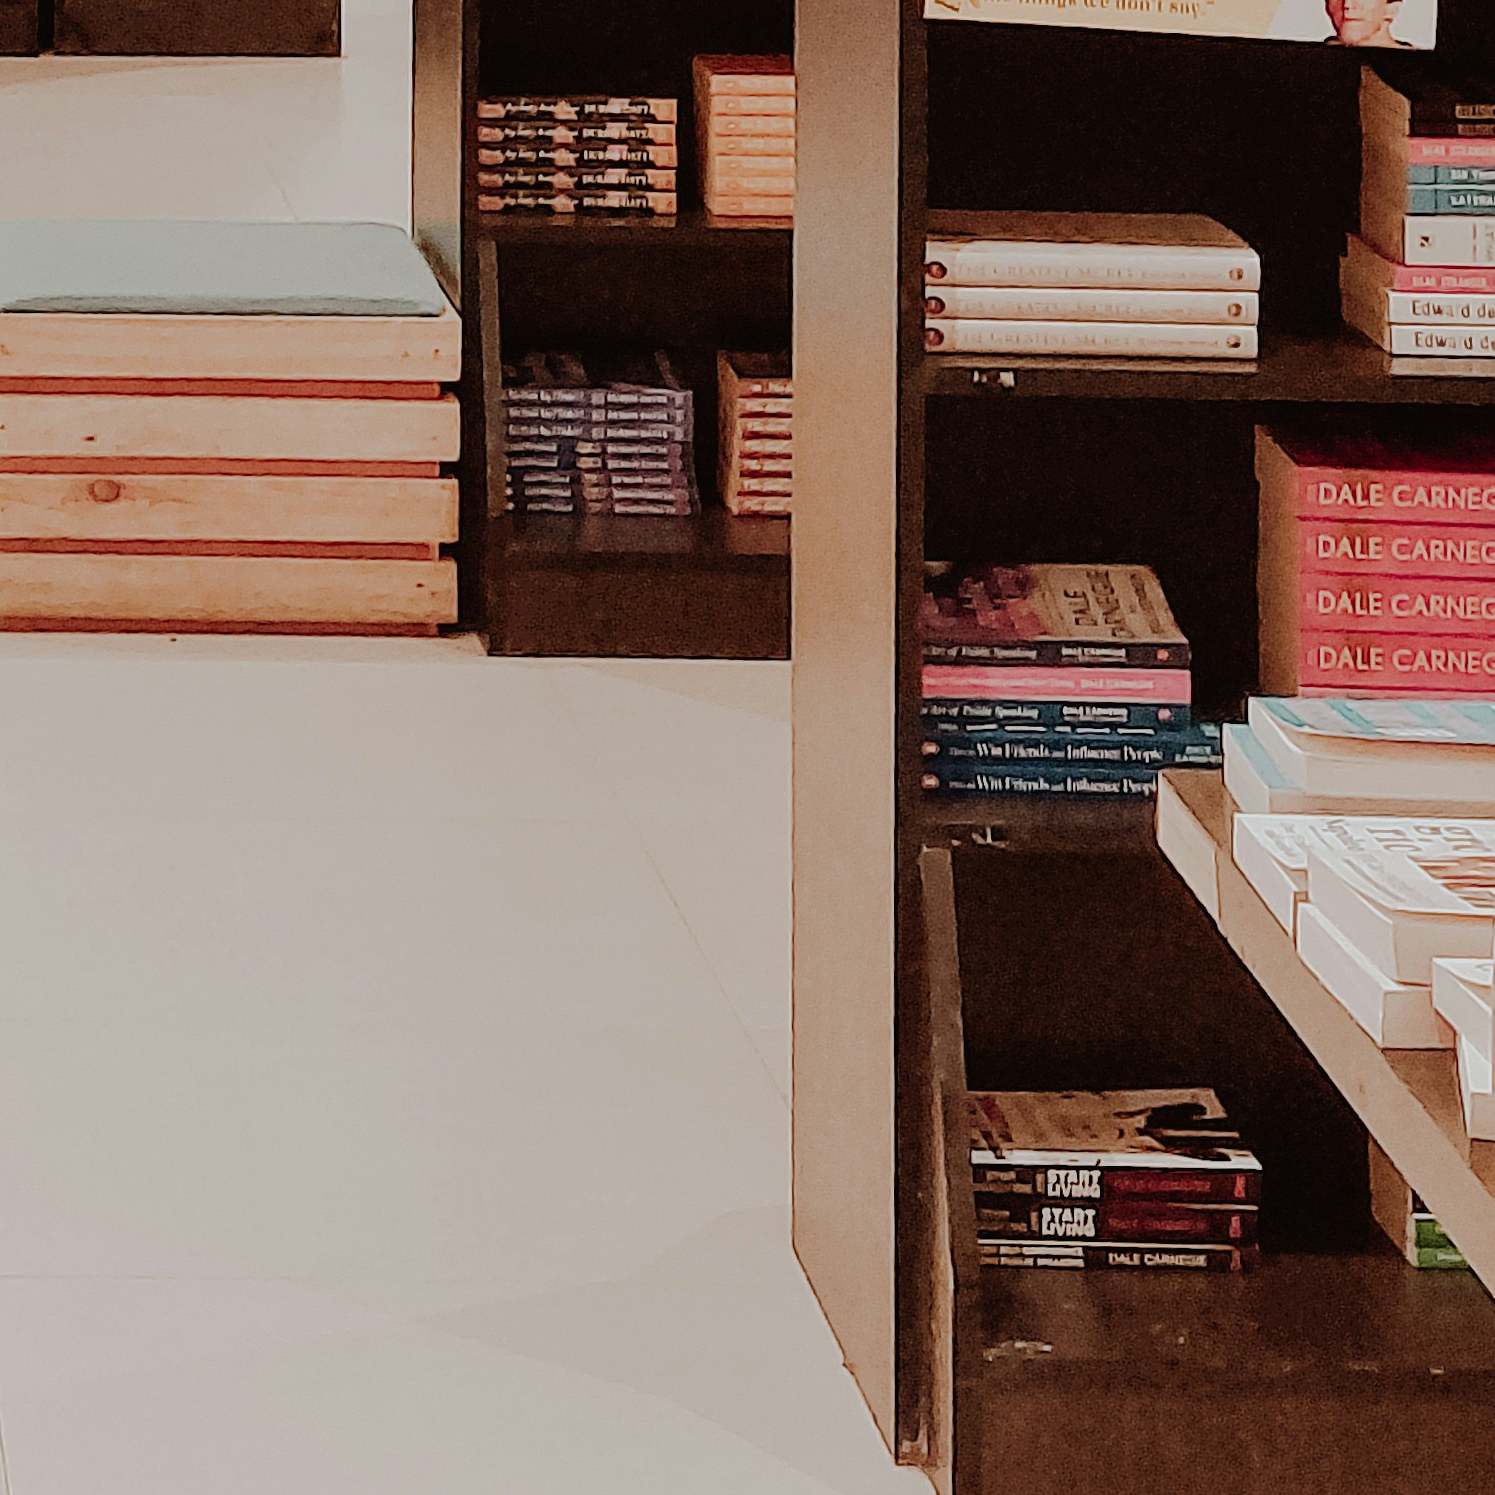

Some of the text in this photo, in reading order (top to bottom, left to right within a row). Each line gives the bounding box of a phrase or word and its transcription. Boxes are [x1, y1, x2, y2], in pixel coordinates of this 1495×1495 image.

[1477, 302, 1495, 319] de
[1318, 482, 1385, 507] DALE
[1317, 534, 1383, 561] DALE
[1317, 590, 1383, 617] DALE
[1318, 646, 1385, 672] DALE
